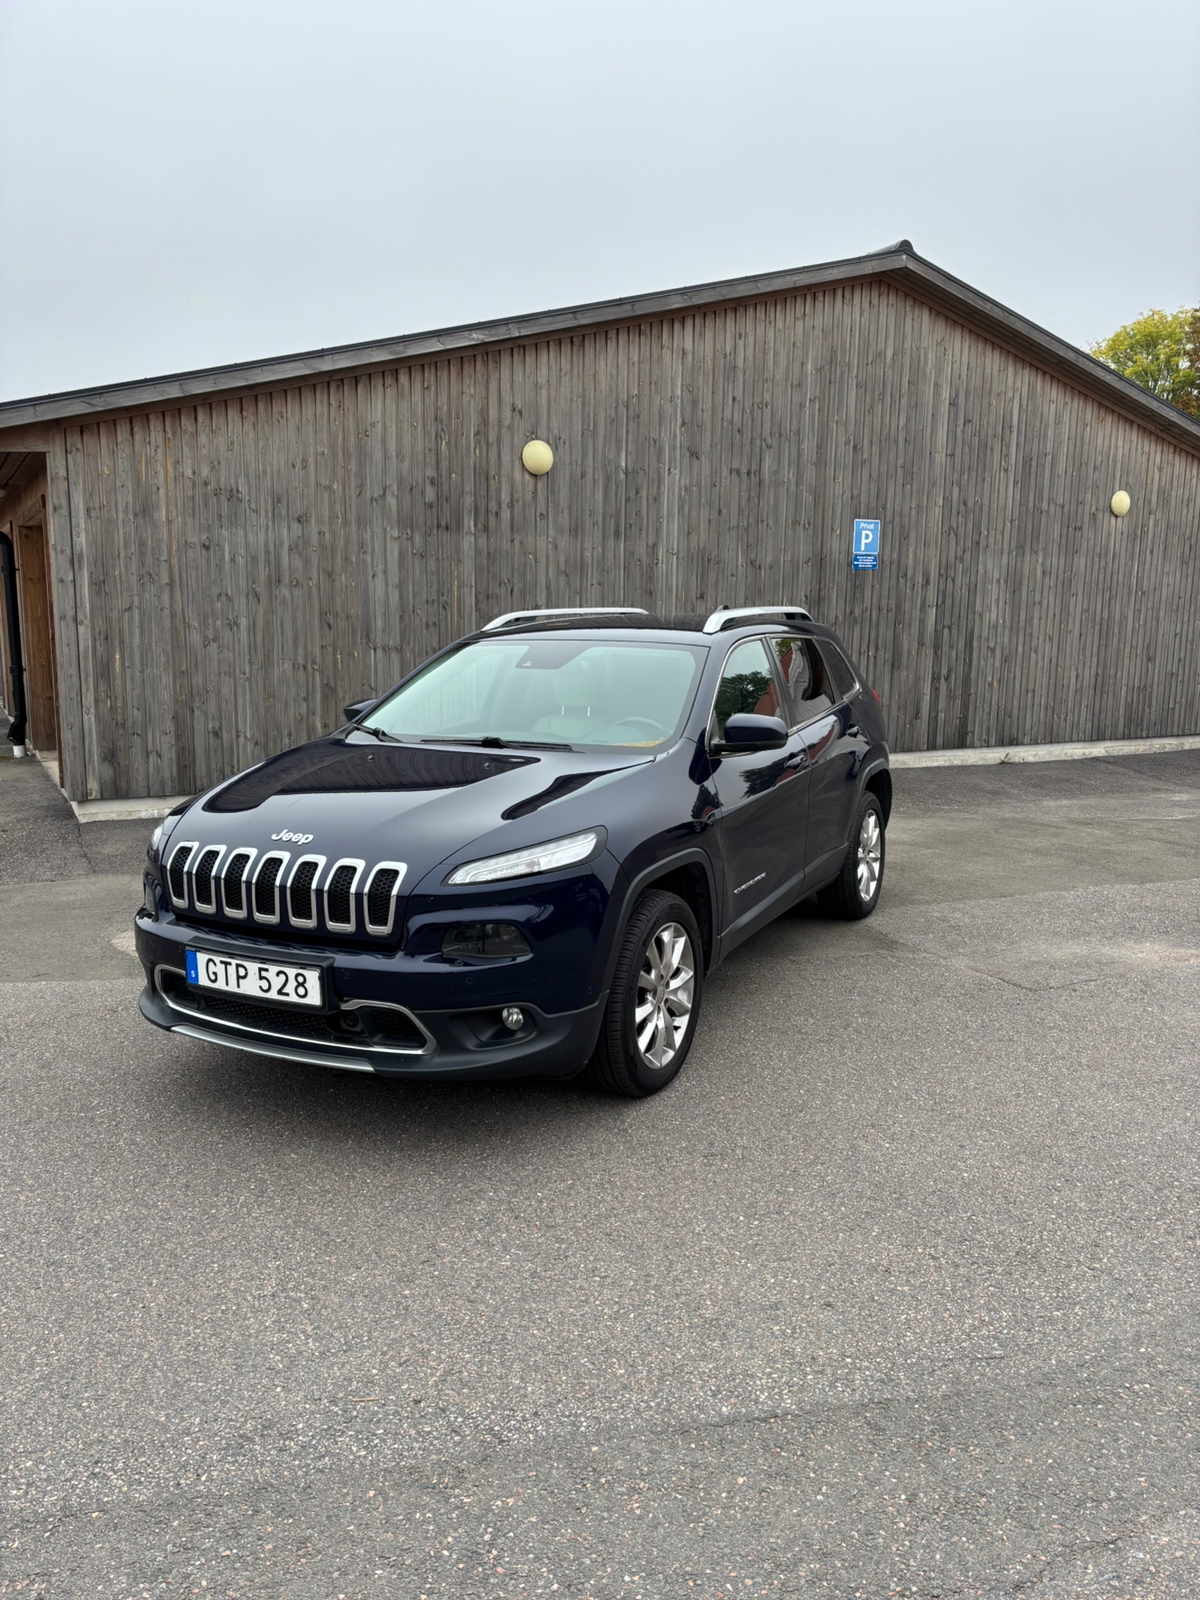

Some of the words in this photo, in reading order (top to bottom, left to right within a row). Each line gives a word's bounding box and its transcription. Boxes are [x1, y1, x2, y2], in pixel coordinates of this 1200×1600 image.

[860, 530, 873, 551] P
[271, 829, 314, 845] Jeep
[205, 957, 248, 989] GTP
[257, 966, 308, 999] 528
